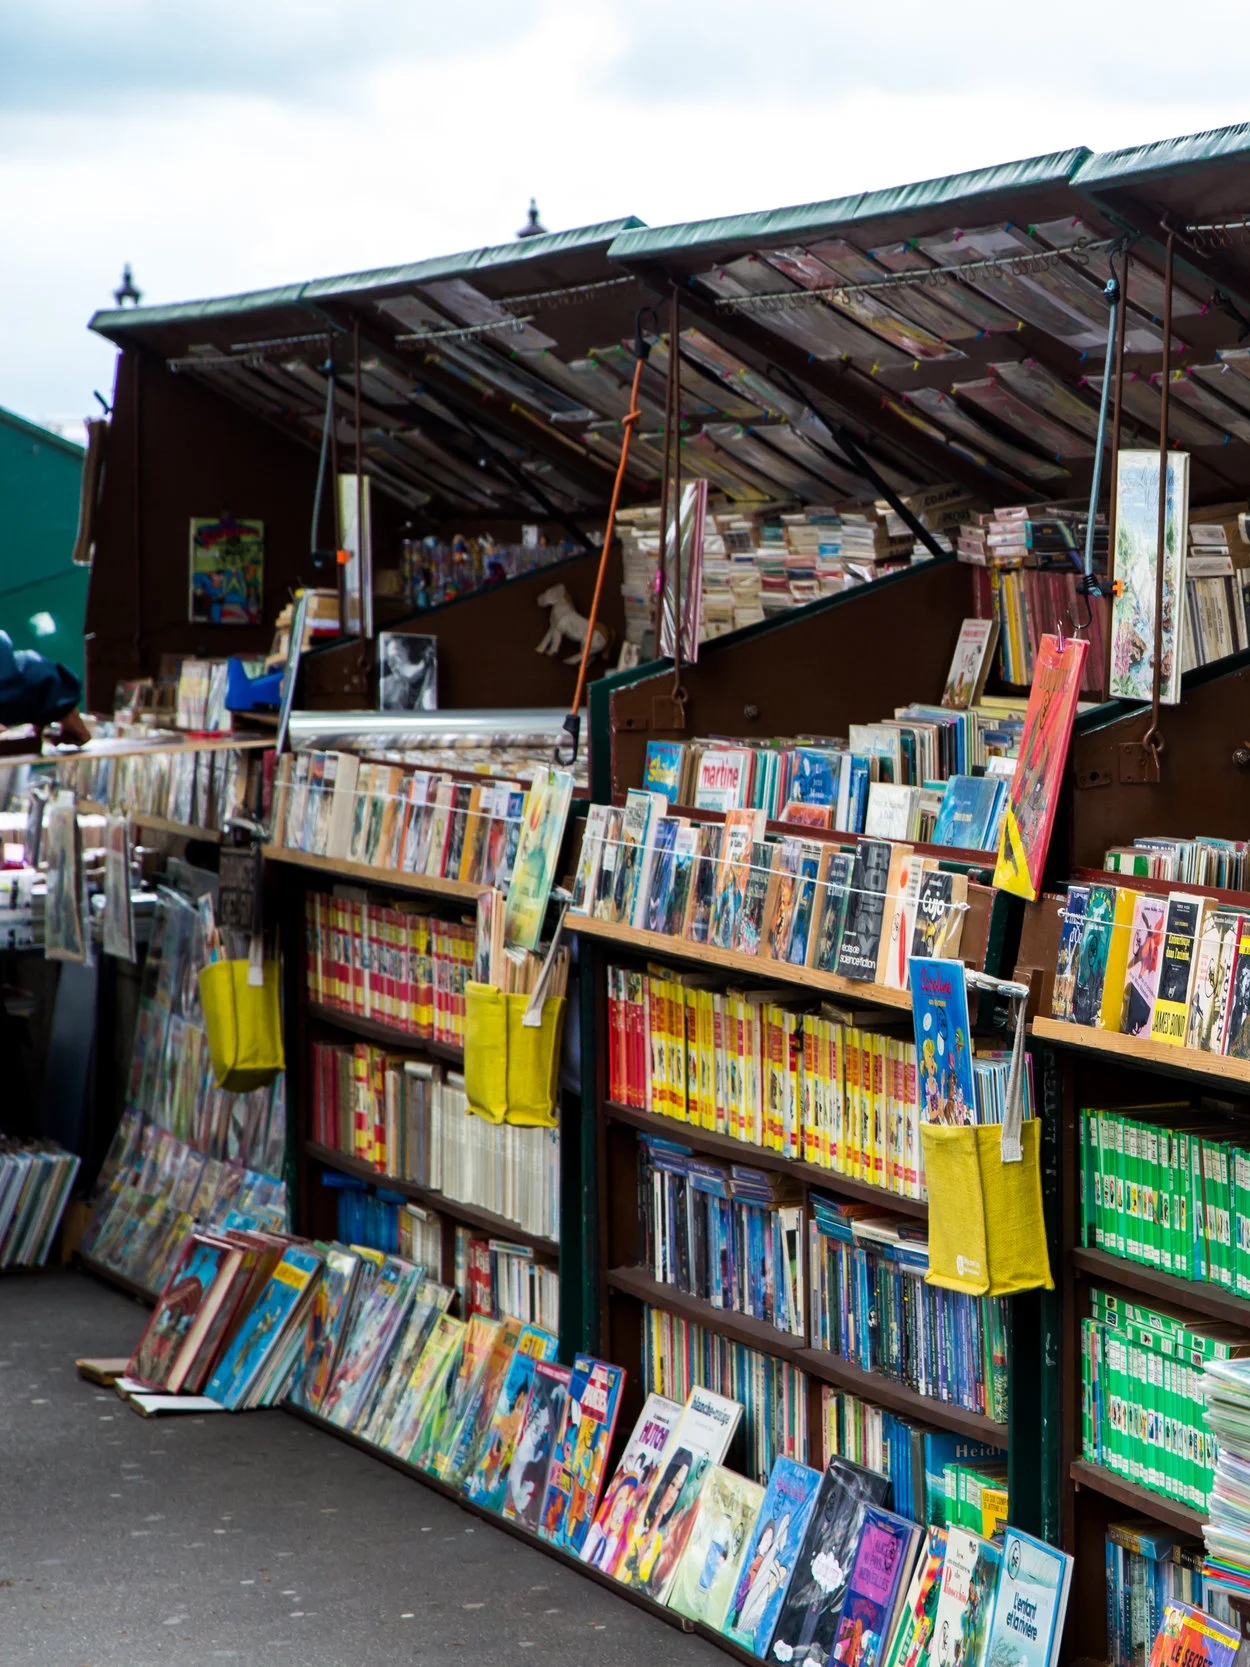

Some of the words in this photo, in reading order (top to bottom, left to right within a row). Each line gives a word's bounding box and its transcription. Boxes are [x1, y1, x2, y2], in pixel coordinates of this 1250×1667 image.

[702, 759, 739, 789] martine
[921, 888, 945, 920] Cujo
[839, 953, 877, 969] science-fiction
[921, 967, 952, 995] Caroline
[1151, 1009, 1171, 1035] JAMES
[1170, 1012, 1186, 1038] BOND
[690, 1394, 732, 1427] blanche-neige
[943, 1565, 967, 1606] Pinocchio
[1012, 1591, 1038, 1618] L'enfant
[1019, 1616, 1038, 1642] rivière
[1169, 1643, 1183, 1663] LE
